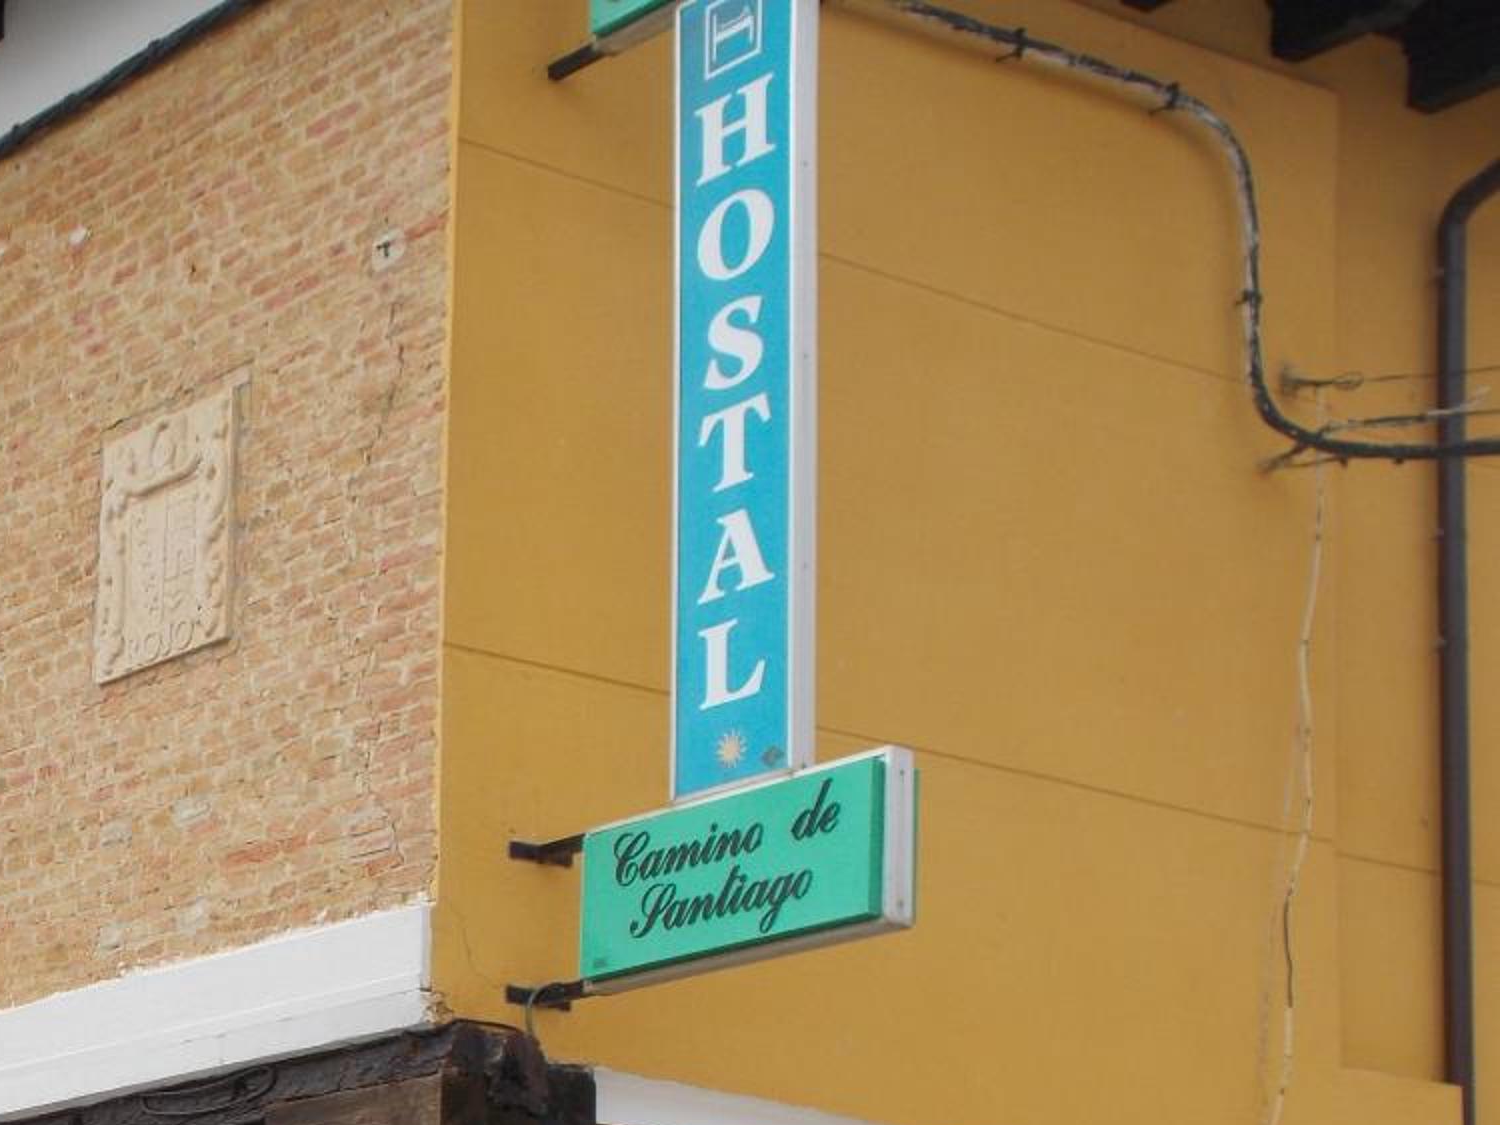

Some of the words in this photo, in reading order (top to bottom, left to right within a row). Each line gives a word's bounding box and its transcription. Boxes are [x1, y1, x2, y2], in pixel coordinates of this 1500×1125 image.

[695, 72, 776, 712] HOSTAL
[613, 821, 764, 888] Camino
[791, 777, 842, 842] de
[629, 864, 814, 939] Santiago
